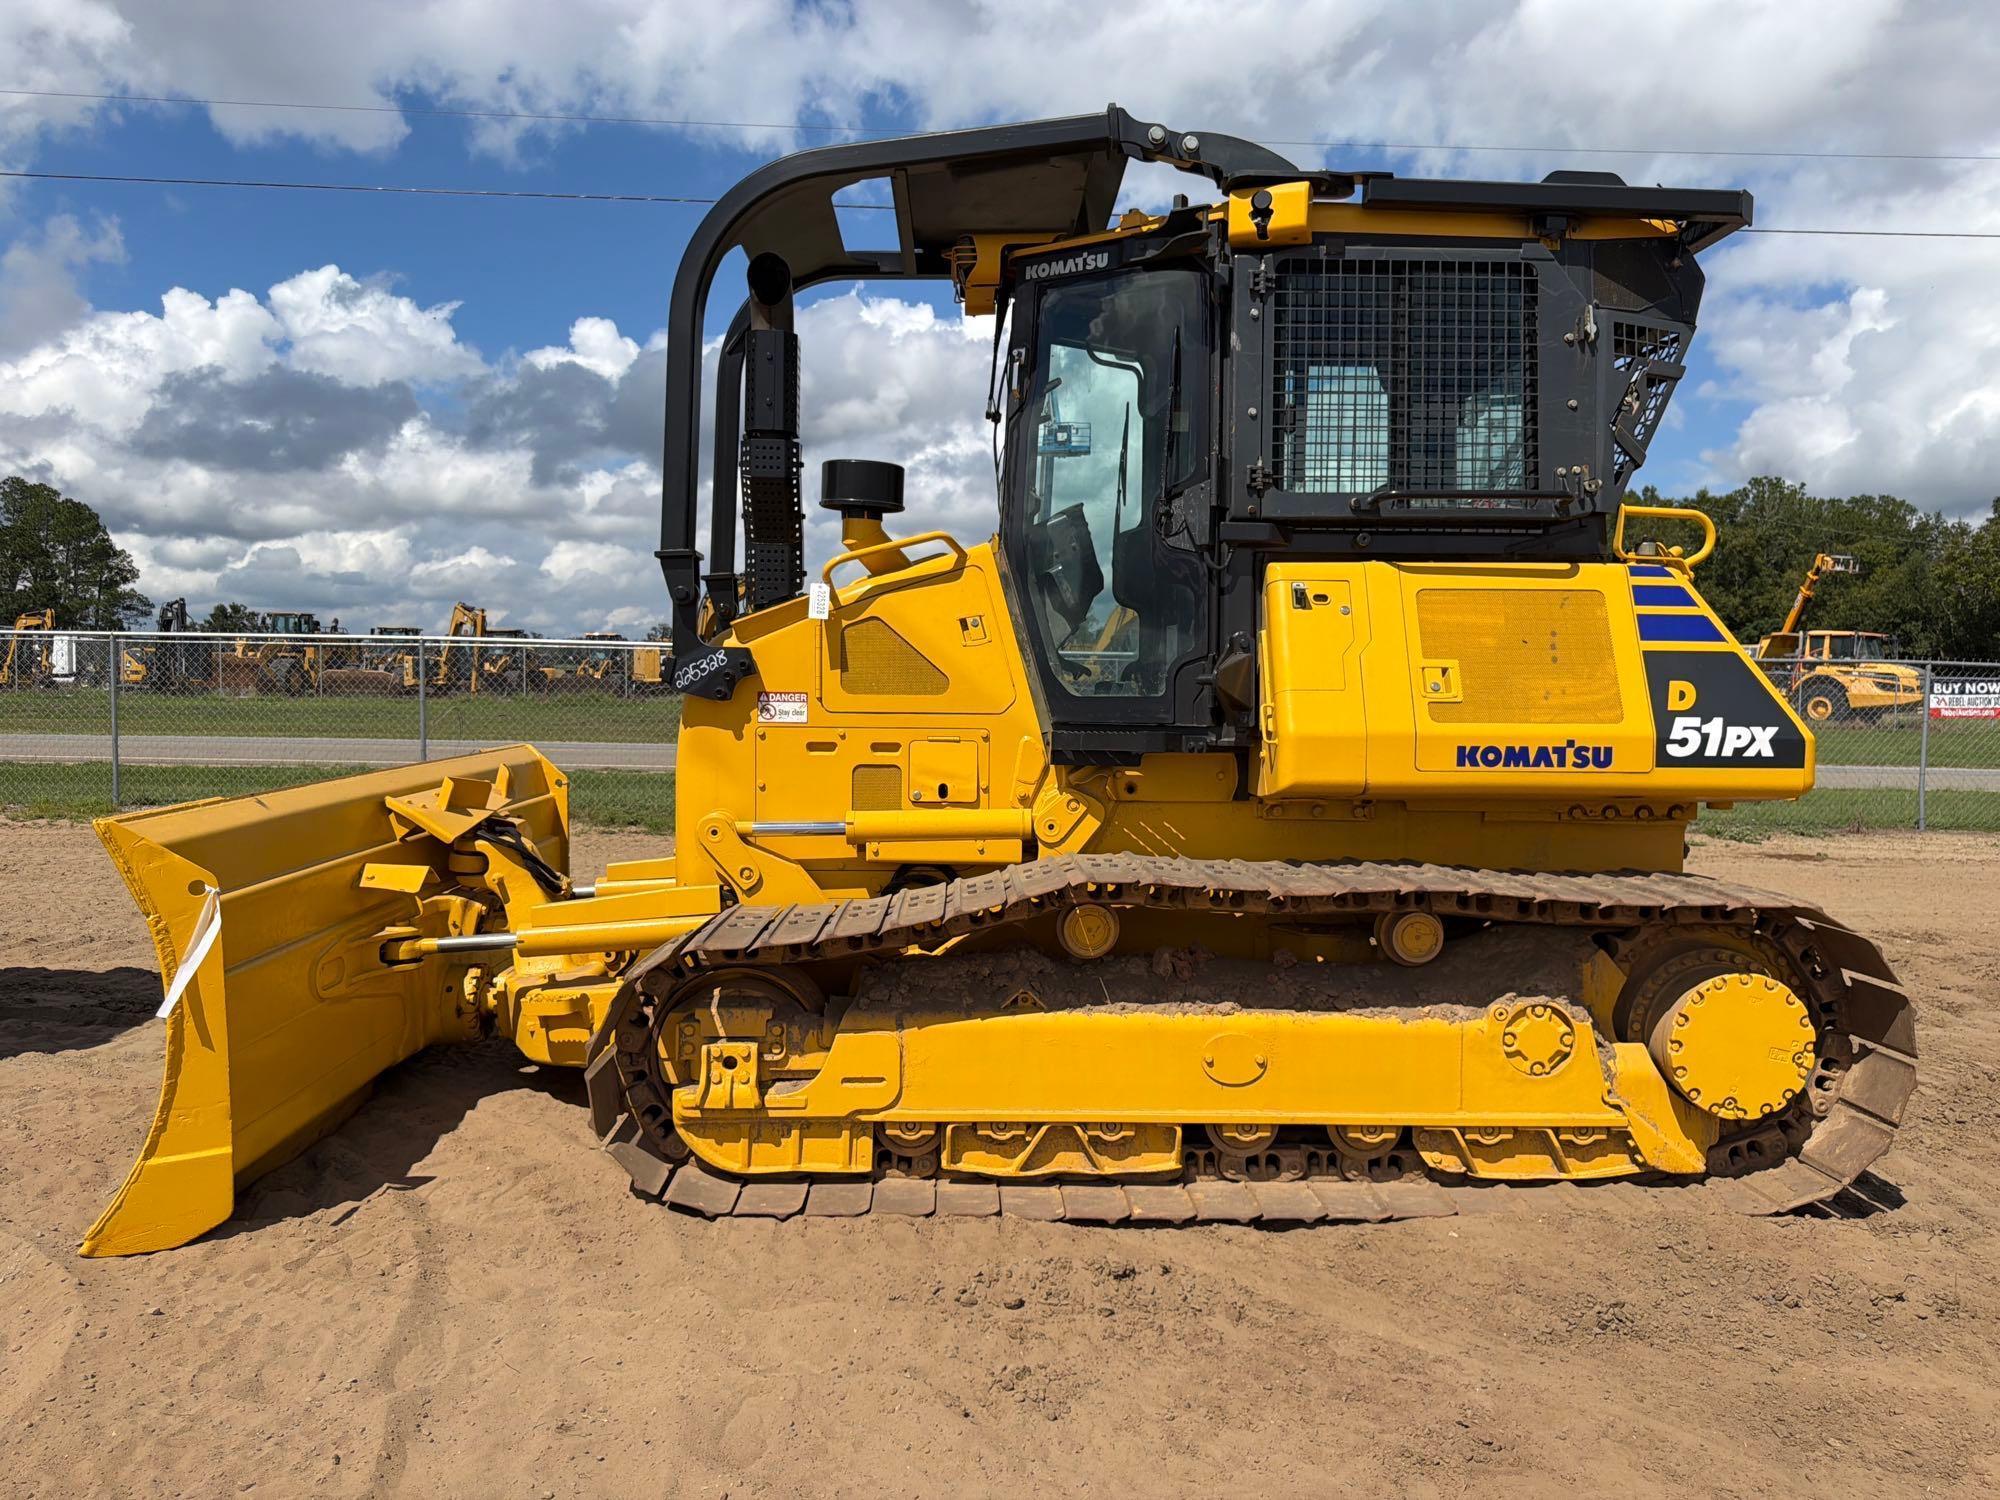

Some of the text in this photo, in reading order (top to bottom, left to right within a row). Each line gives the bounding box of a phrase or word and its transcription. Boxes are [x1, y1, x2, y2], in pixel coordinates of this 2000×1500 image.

[1025, 252, 1109, 280] KOMATSU
[674, 649, 728, 688] 225328
[769, 693, 808, 702] DANGER
[1667, 680, 1697, 711] D
[1933, 682, 2000, 694] BUY NOW
[1967, 696, 1992, 706] AUCTION
[778, 707, 806, 717] Stay clear
[1665, 716, 1779, 758] 51PX
[1456, 739, 1613, 768] KOMATSU
